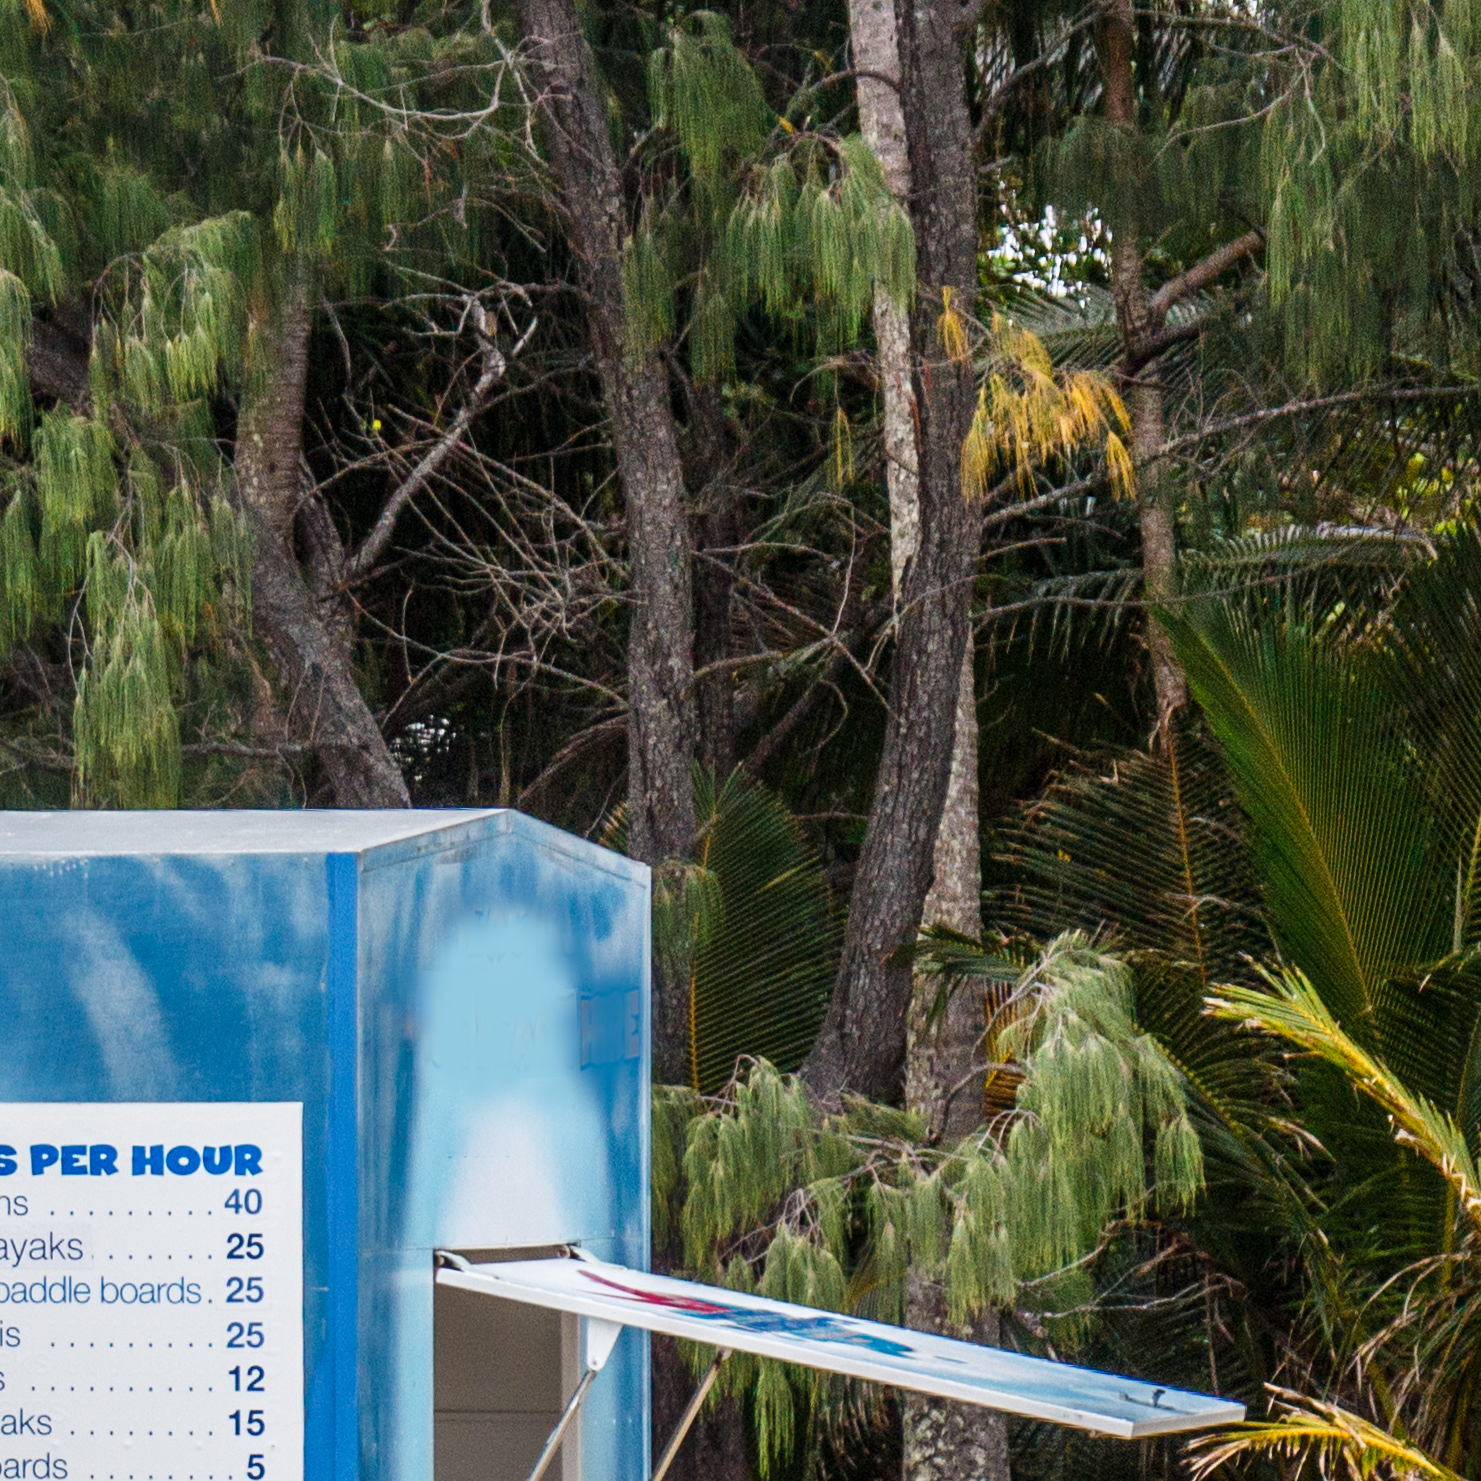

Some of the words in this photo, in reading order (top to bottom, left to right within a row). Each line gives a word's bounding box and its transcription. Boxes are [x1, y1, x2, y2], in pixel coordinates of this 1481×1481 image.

[30, 1143, 119, 1177] PER
[132, 1143, 264, 1177] HOUR
[224, 1188, 263, 1215] 40
[226, 1232, 265, 1260] 25
[225, 1276, 264, 1304] 25
[226, 1321, 265, 1349] 25
[228, 1365, 265, 1393] 12
[228, 1409, 266, 1437] 15
[246, 1453, 266, 1481] 5
